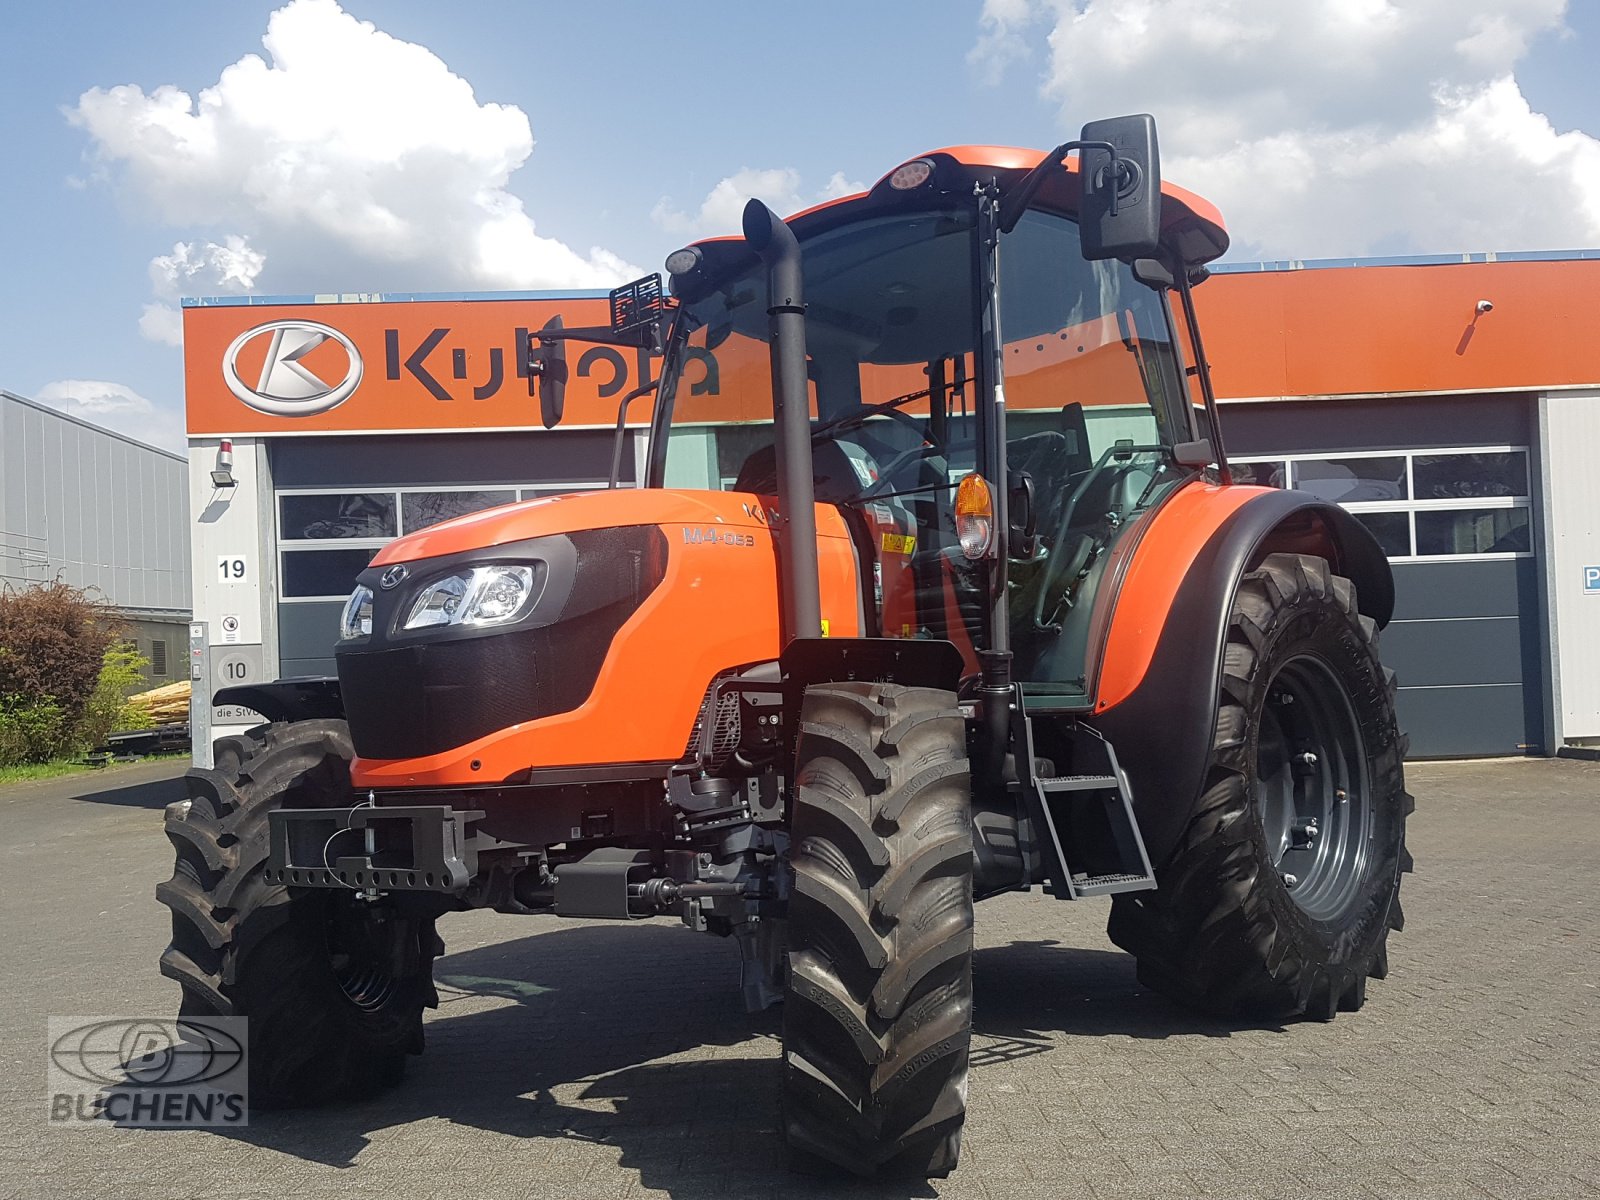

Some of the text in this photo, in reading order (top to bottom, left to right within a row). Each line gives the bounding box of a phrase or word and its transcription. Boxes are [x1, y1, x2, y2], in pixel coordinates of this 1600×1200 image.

[219, 559, 245, 579] 19
[1586, 568, 1600, 588] P
[227, 662, 246, 679] 10
[216, 708, 232, 718] die
